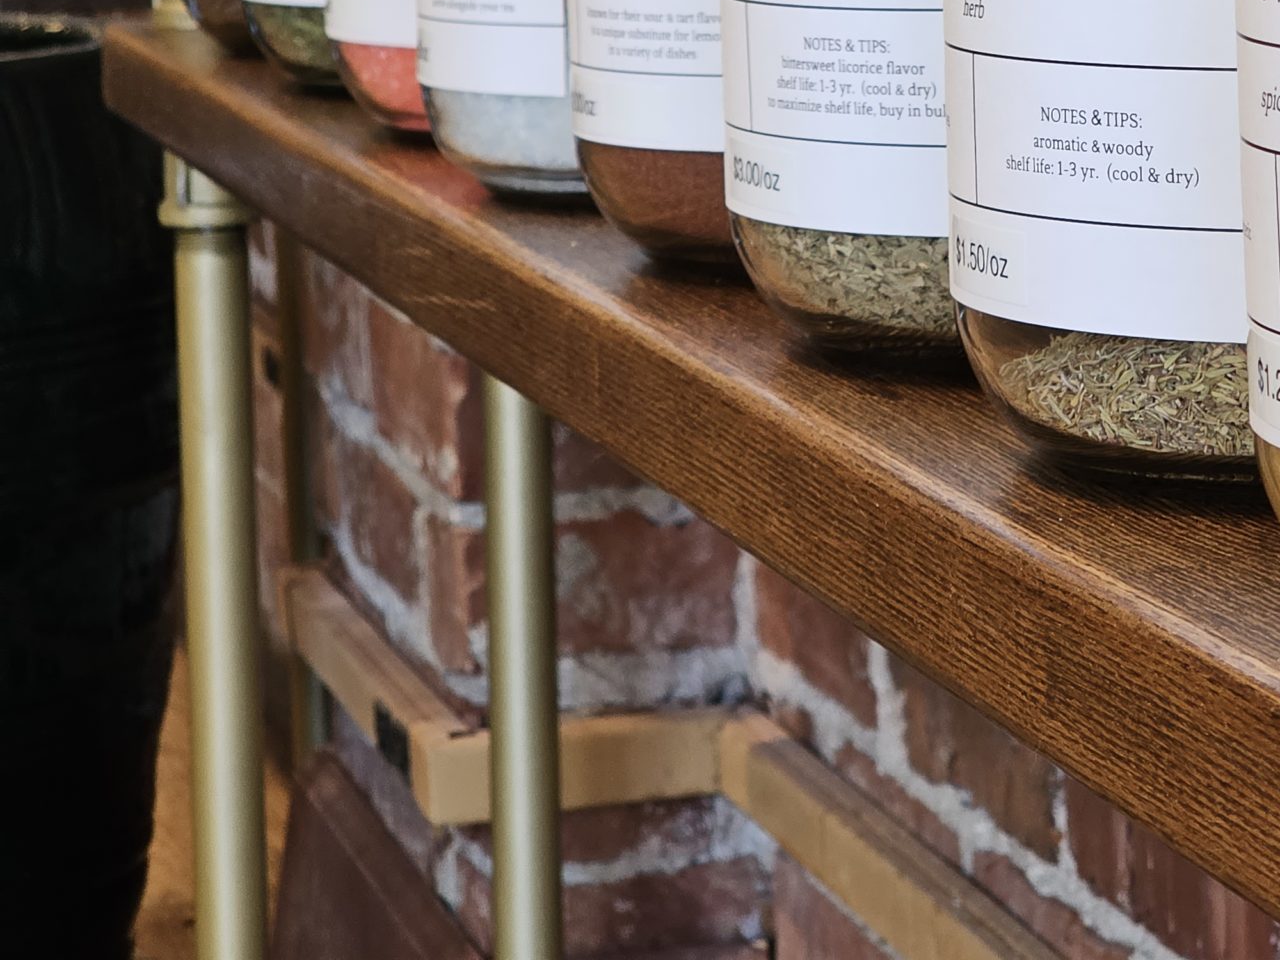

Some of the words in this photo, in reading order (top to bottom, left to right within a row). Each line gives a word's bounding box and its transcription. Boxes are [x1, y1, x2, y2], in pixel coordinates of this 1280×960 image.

[691, 30, 721, 43] lemo
[803, 36, 842, 52] NOTES
[845, 39, 855, 53] &
[858, 40, 890, 54] TIPS:
[781, 55, 836, 73] bittersweet
[838, 58, 883, 75] licorice
[886, 61, 926, 75] flavor
[776, 76, 797, 90] shelf
[820, 79, 837, 93] 1-3
[839, 84, 855, 97] yr.
[861, 80, 891, 97] (cool
[895, 84, 905, 96] &
[908, 80, 937, 100] dry)
[777, 97, 822, 113] maximize
[824, 100, 851, 115] shelf
[853, 102, 878, 117] life,
[879, 103, 904, 120] buy
[908, 104, 921, 117] in
[925, 104, 946, 118] bul
[1040, 106, 1087, 125] NOTES
[1091, 108, 1102, 127] &
[1103, 111, 1143, 129] TIPS:
[1033, 136, 1088, 153] aromatic
[1091, 139, 1101, 153] &
[1102, 140, 1154, 161] woody
[1006, 154, 1030, 173] shelf
[1032, 156, 1055, 175] life:
[1057, 161, 1077, 177] 1-3
[1080, 166, 1099, 183] yr.
[1107, 162, 1144, 183] (cool
[1148, 167, 1160, 184] &
[1165, 167, 1200, 190] dry)
[956, 234, 1009, 279] $1.50/oz
